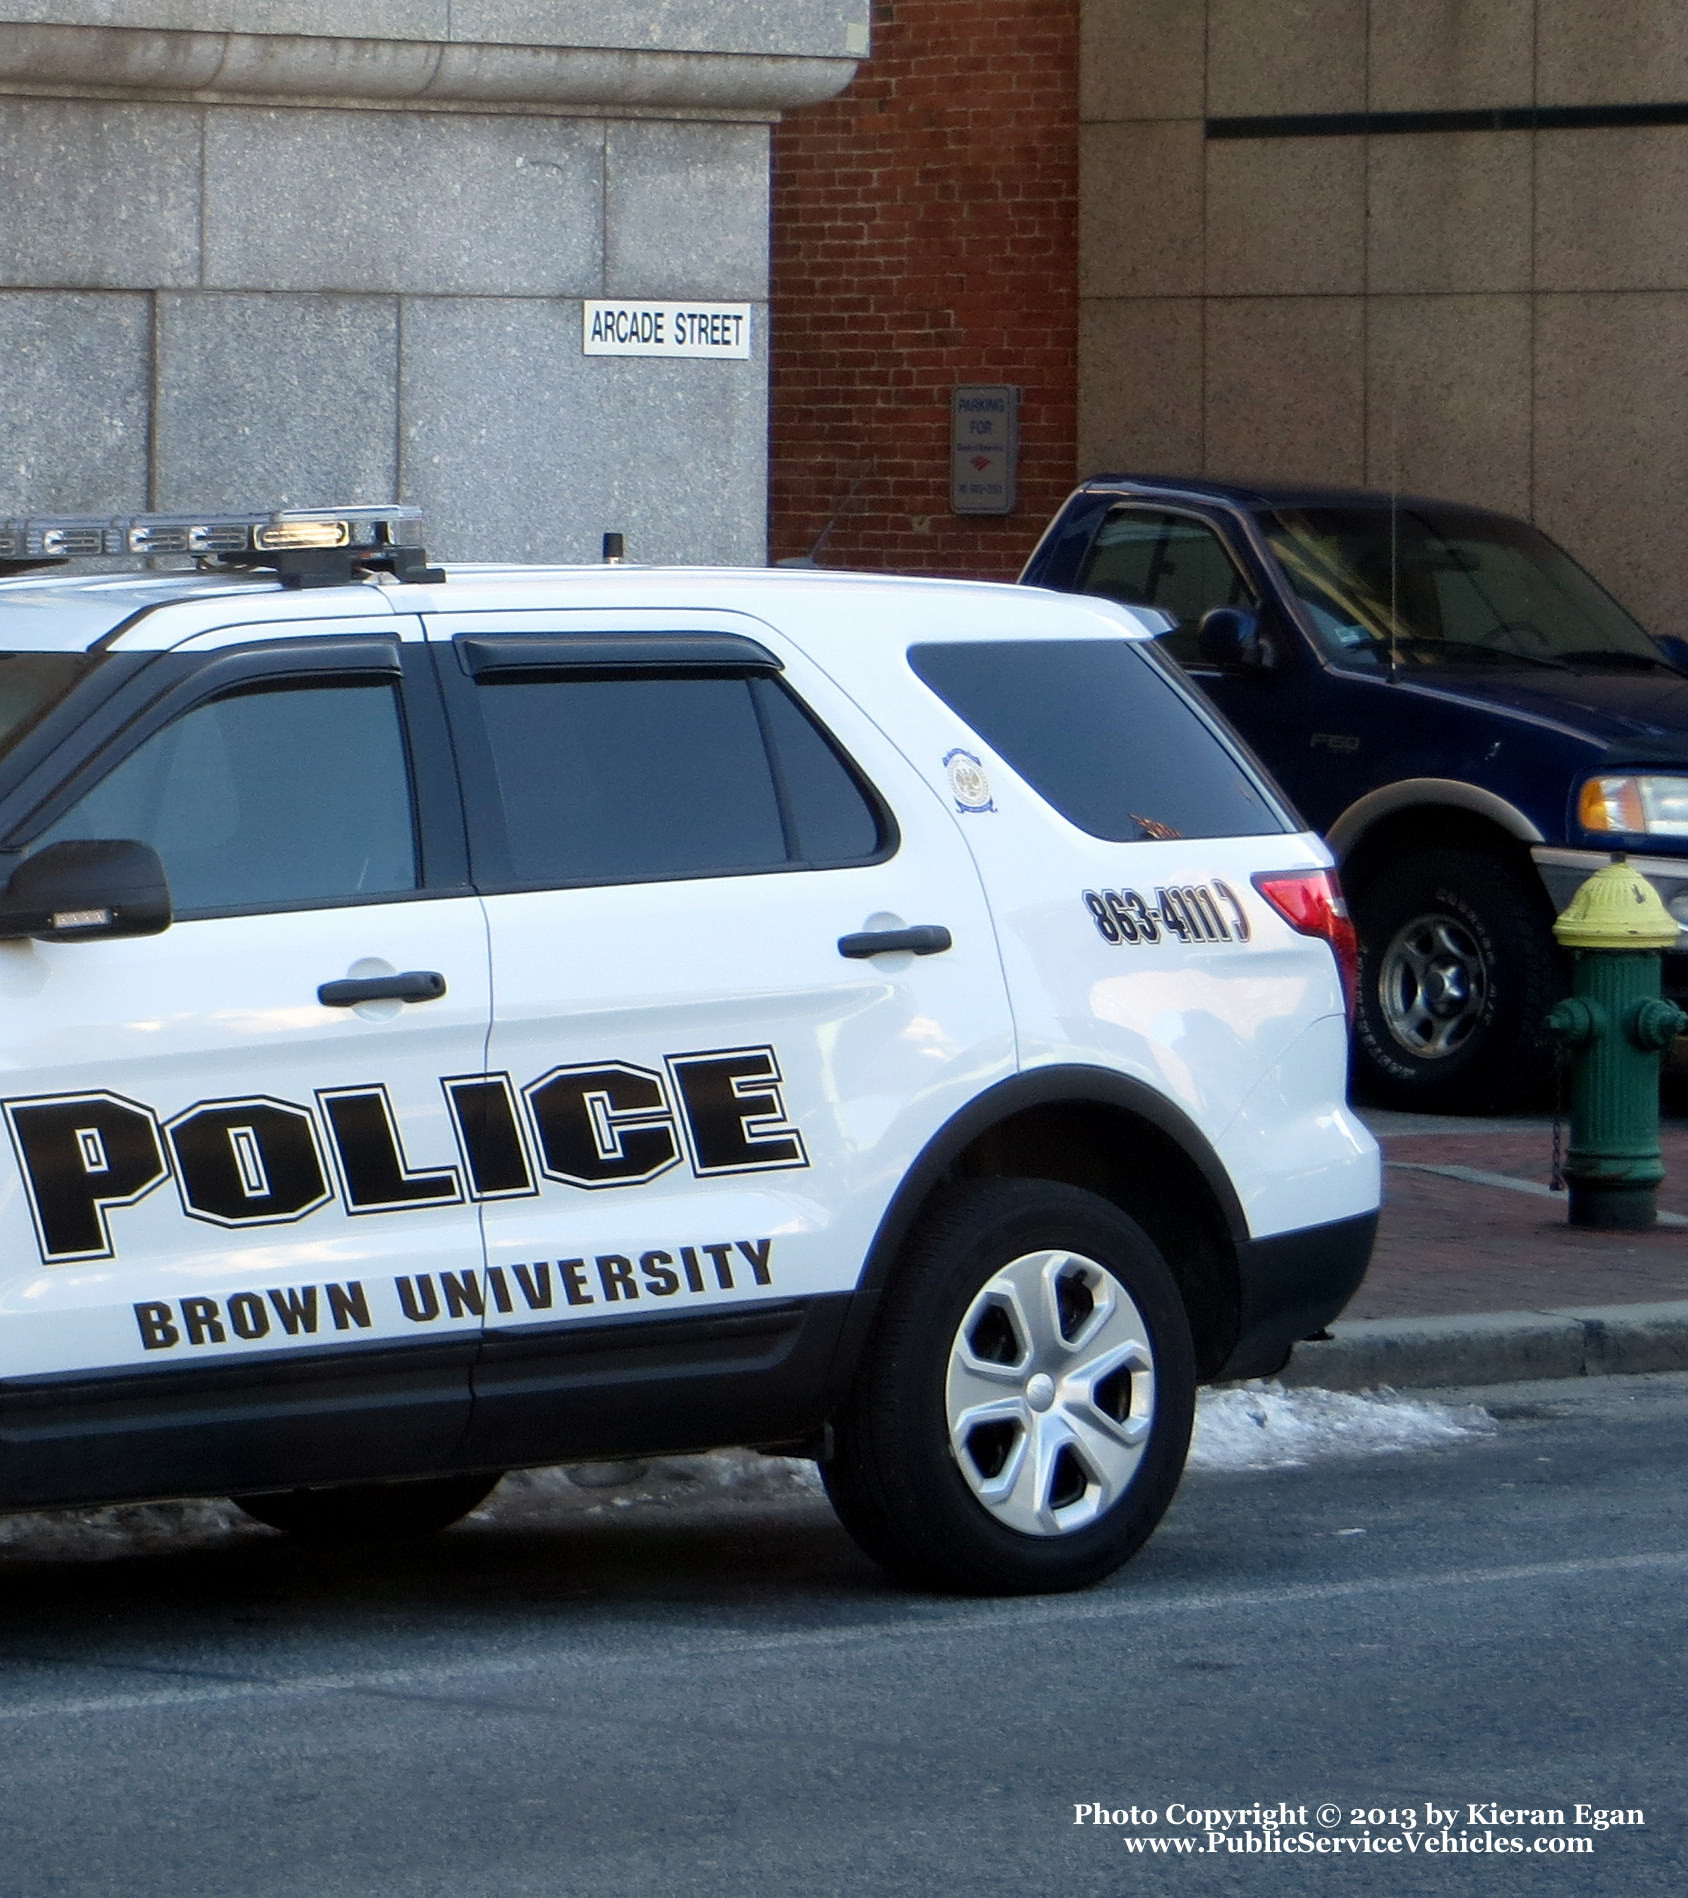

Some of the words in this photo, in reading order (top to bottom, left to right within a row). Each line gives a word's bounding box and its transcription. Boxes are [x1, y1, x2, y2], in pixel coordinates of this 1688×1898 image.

[591, 310, 664, 344] ARCADE
[674, 312, 743, 346] STREET
[958, 398, 1004, 412] PARKING
[970, 420, 992, 434] FOR
[1082, 885, 1233, 945] 863-4111
[132, 1280, 372, 1351] BROWN
[394, 1238, 773, 1322] UNIVERSITY
